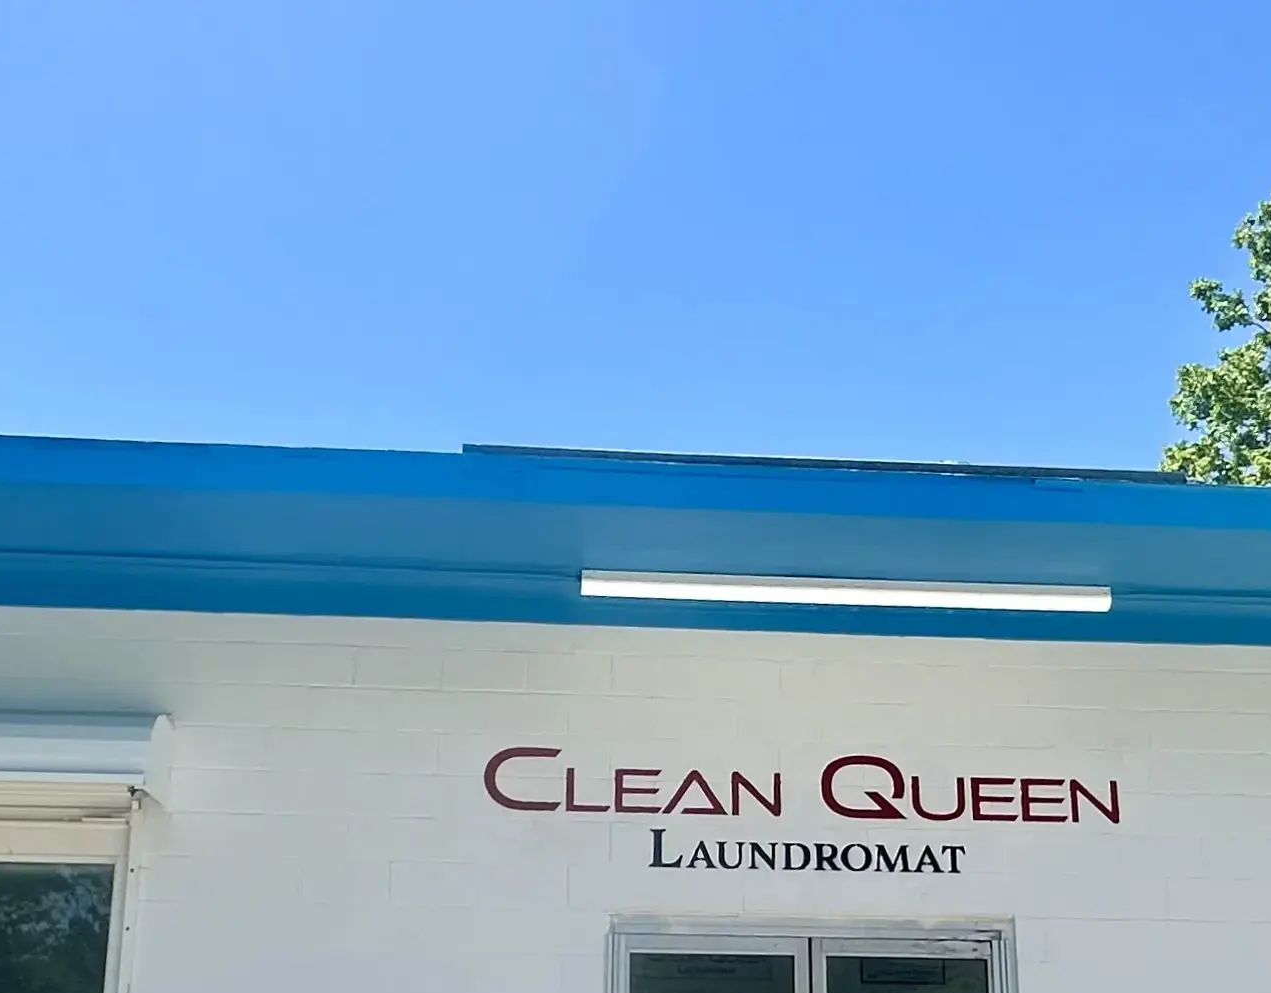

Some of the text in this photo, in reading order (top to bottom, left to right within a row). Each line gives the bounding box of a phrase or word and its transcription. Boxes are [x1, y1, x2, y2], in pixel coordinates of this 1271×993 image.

[483, 746, 1120, 825] CLEAN QUEEN
[648, 827, 967, 875] LAUNDROMAT
